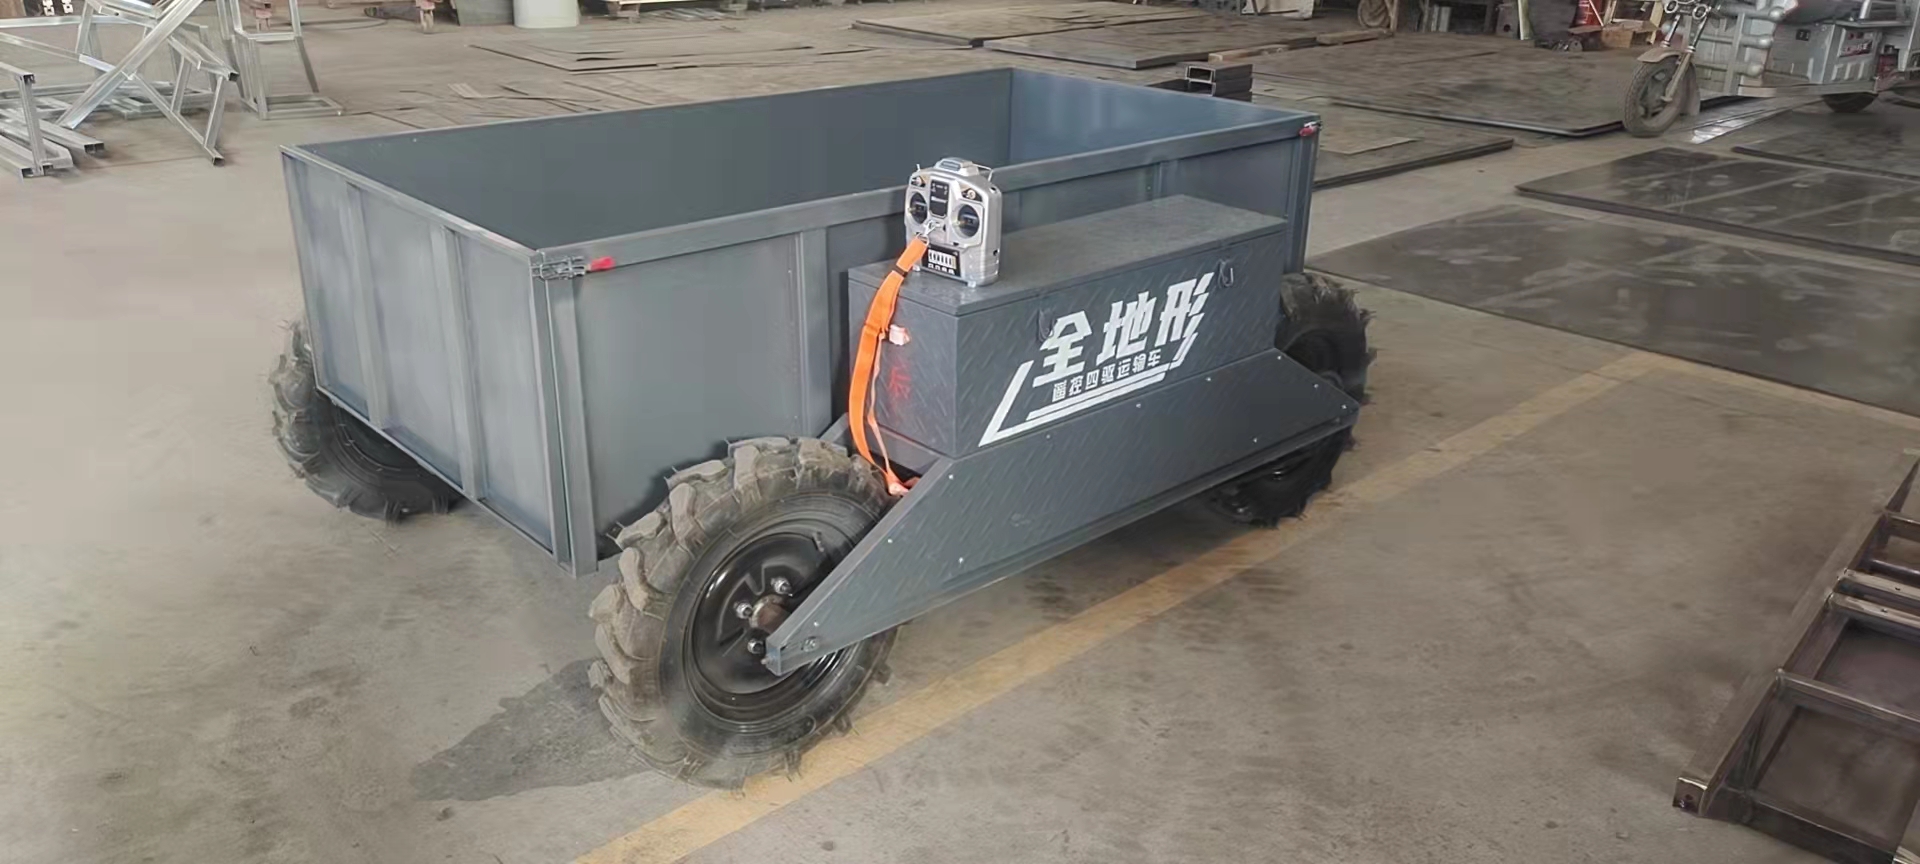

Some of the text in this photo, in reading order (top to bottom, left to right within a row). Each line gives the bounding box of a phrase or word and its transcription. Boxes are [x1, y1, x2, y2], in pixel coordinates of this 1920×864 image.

[1032, 272, 1215, 387] 全地形
[1052, 348, 1162, 402] 遥控四驱运输车
